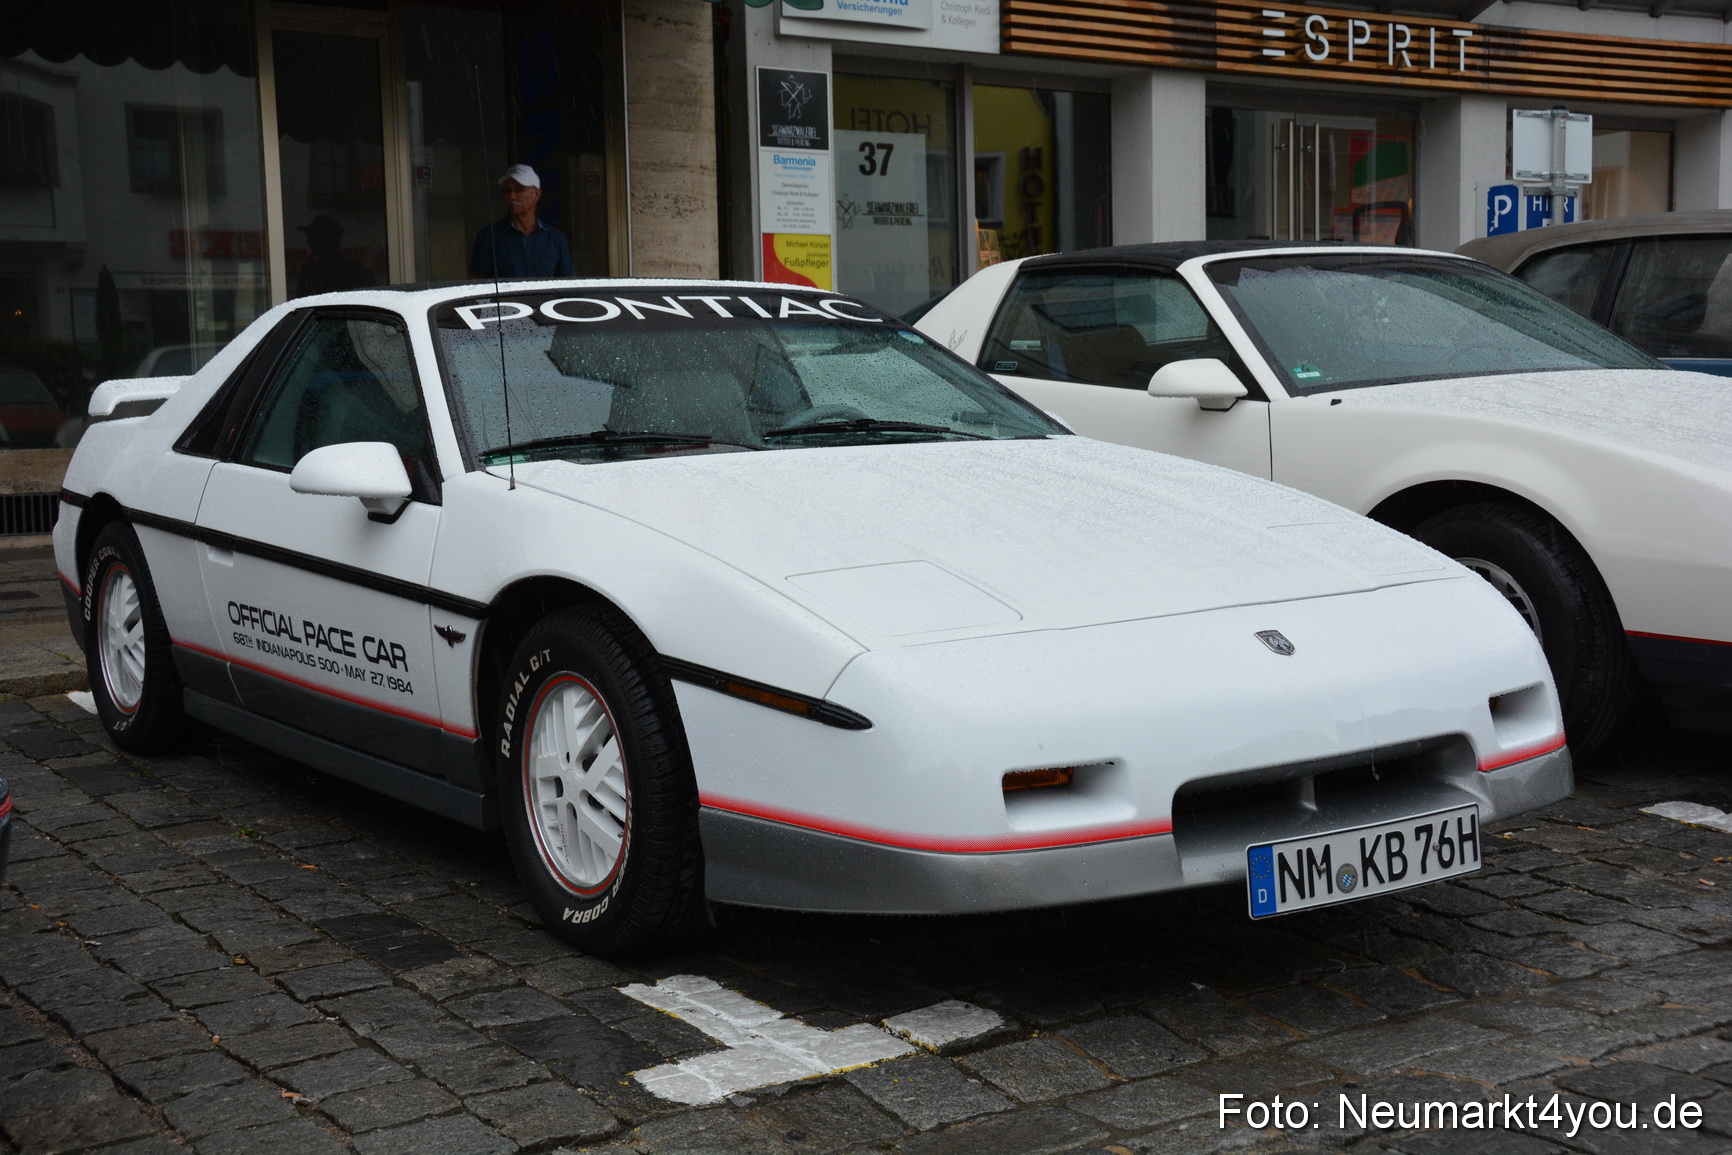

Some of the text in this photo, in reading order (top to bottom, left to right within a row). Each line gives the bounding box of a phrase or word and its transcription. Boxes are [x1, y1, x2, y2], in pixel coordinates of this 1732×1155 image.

[837, 1, 903, 17] Versicherungen
[941, 2, 992, 16] Christoph Riedl
[941, 14, 977, 29] & Kollegen
[1261, 9, 1474, 72] ESPRIT
[773, 154, 816, 167] Barmenia
[858, 141, 894, 176] 37
[1493, 194, 1513, 229] P
[1532, 196, 1569, 213] HIR
[786, 240, 829, 249] Michael Künzel
[784, 257, 830, 270] Fußpfleger
[453, 294, 884, 331] PONTIAC
[85, 558, 100, 622] COOPER
[227, 600, 409, 673] OFFICIAL PACE CAR
[232, 631, 254, 649] 68TH
[255, 638, 317, 668] INDIANAPOLIS
[501, 649, 551, 759] RADIAL G/T
[1277, 813, 1479, 904] NM KB 76H
[562, 896, 609, 924] COBRA
[1258, 888, 1268, 904] D
